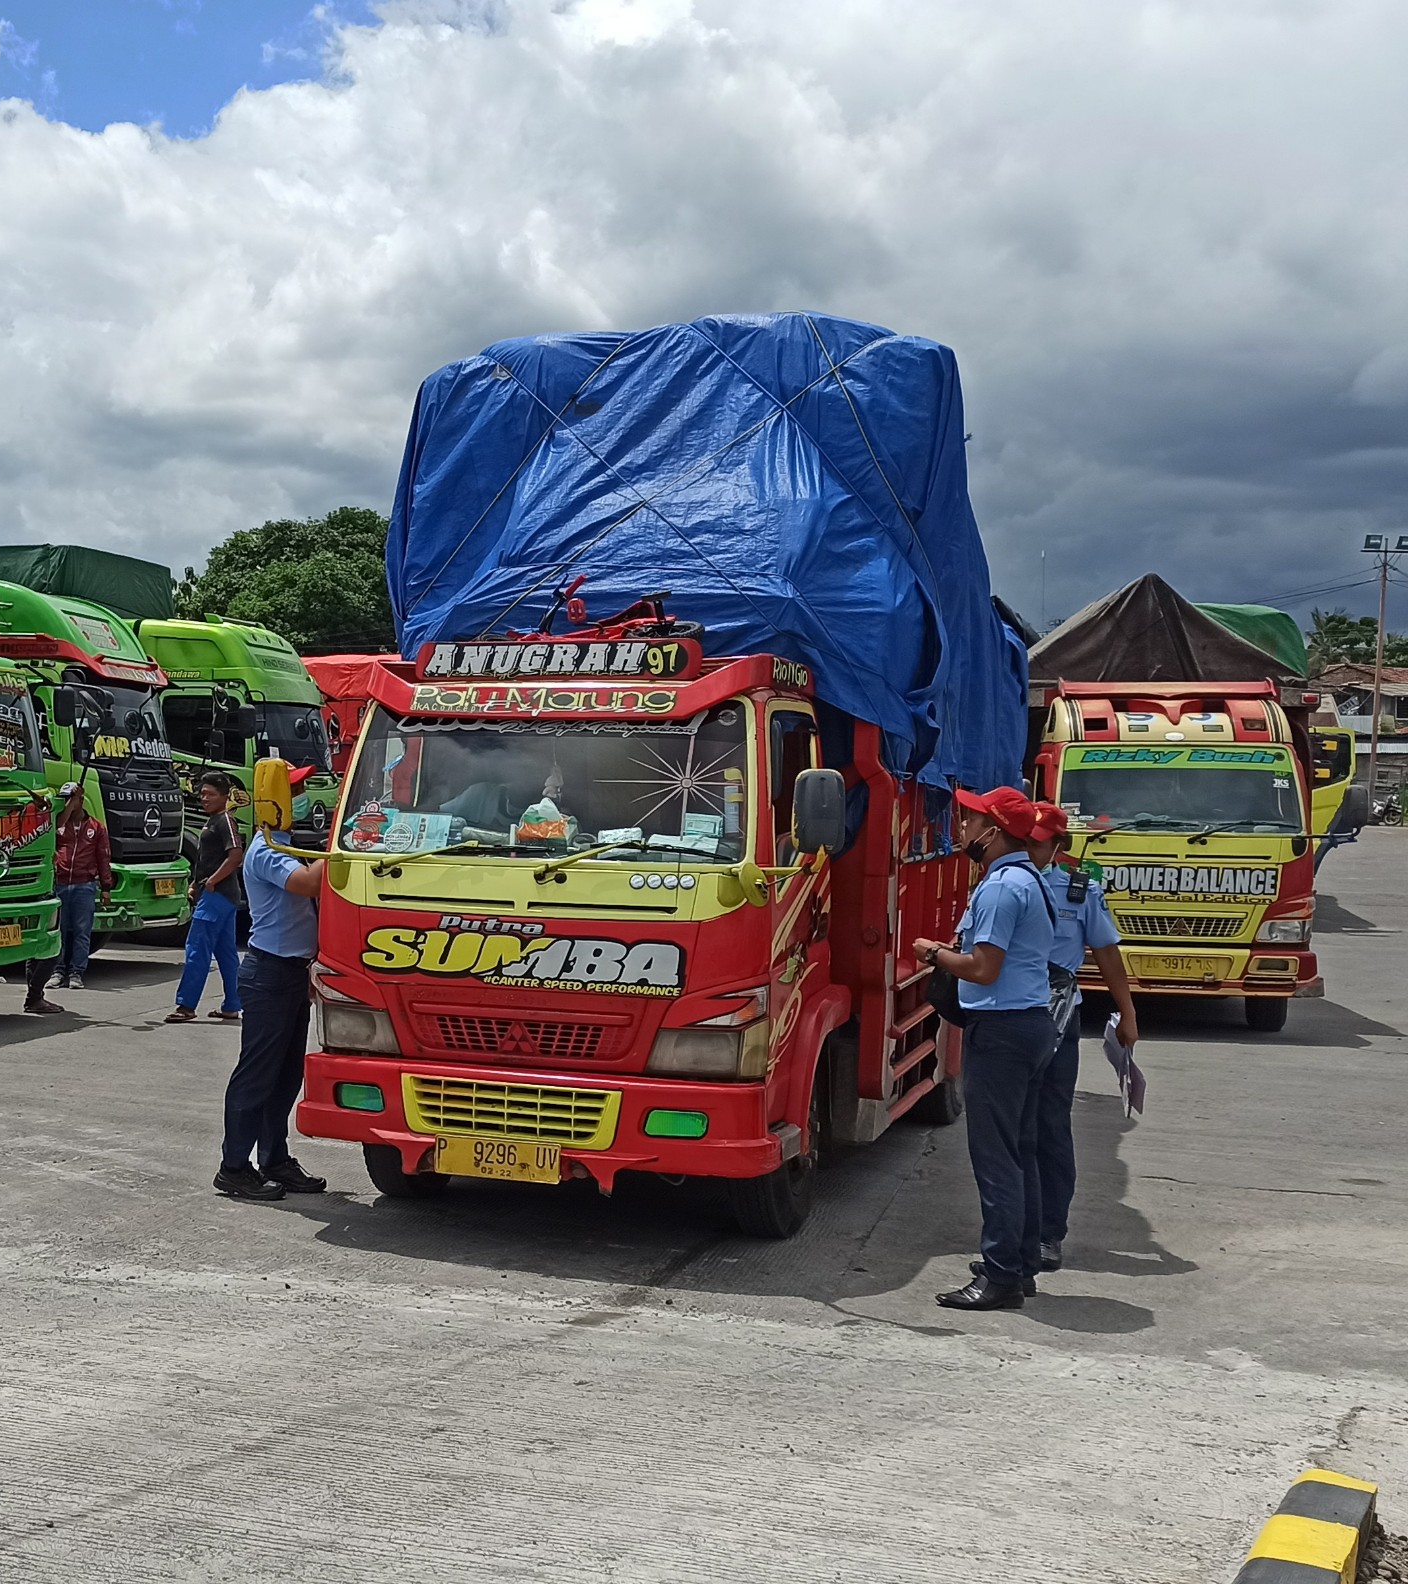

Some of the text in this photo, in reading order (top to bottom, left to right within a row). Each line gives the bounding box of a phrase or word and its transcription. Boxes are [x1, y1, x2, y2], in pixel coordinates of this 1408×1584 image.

[425, 642, 679, 675] ANUGRAH 97
[1081, 748, 1276, 765] Rizky Buah
[440, 915, 544, 935] Putra
[361, 927, 683, 986] SUMBA
[483, 975, 682, 997] #CANTER SPEED PERFORMANCE
[438, 1138, 558, 1170] P 9296 UV
